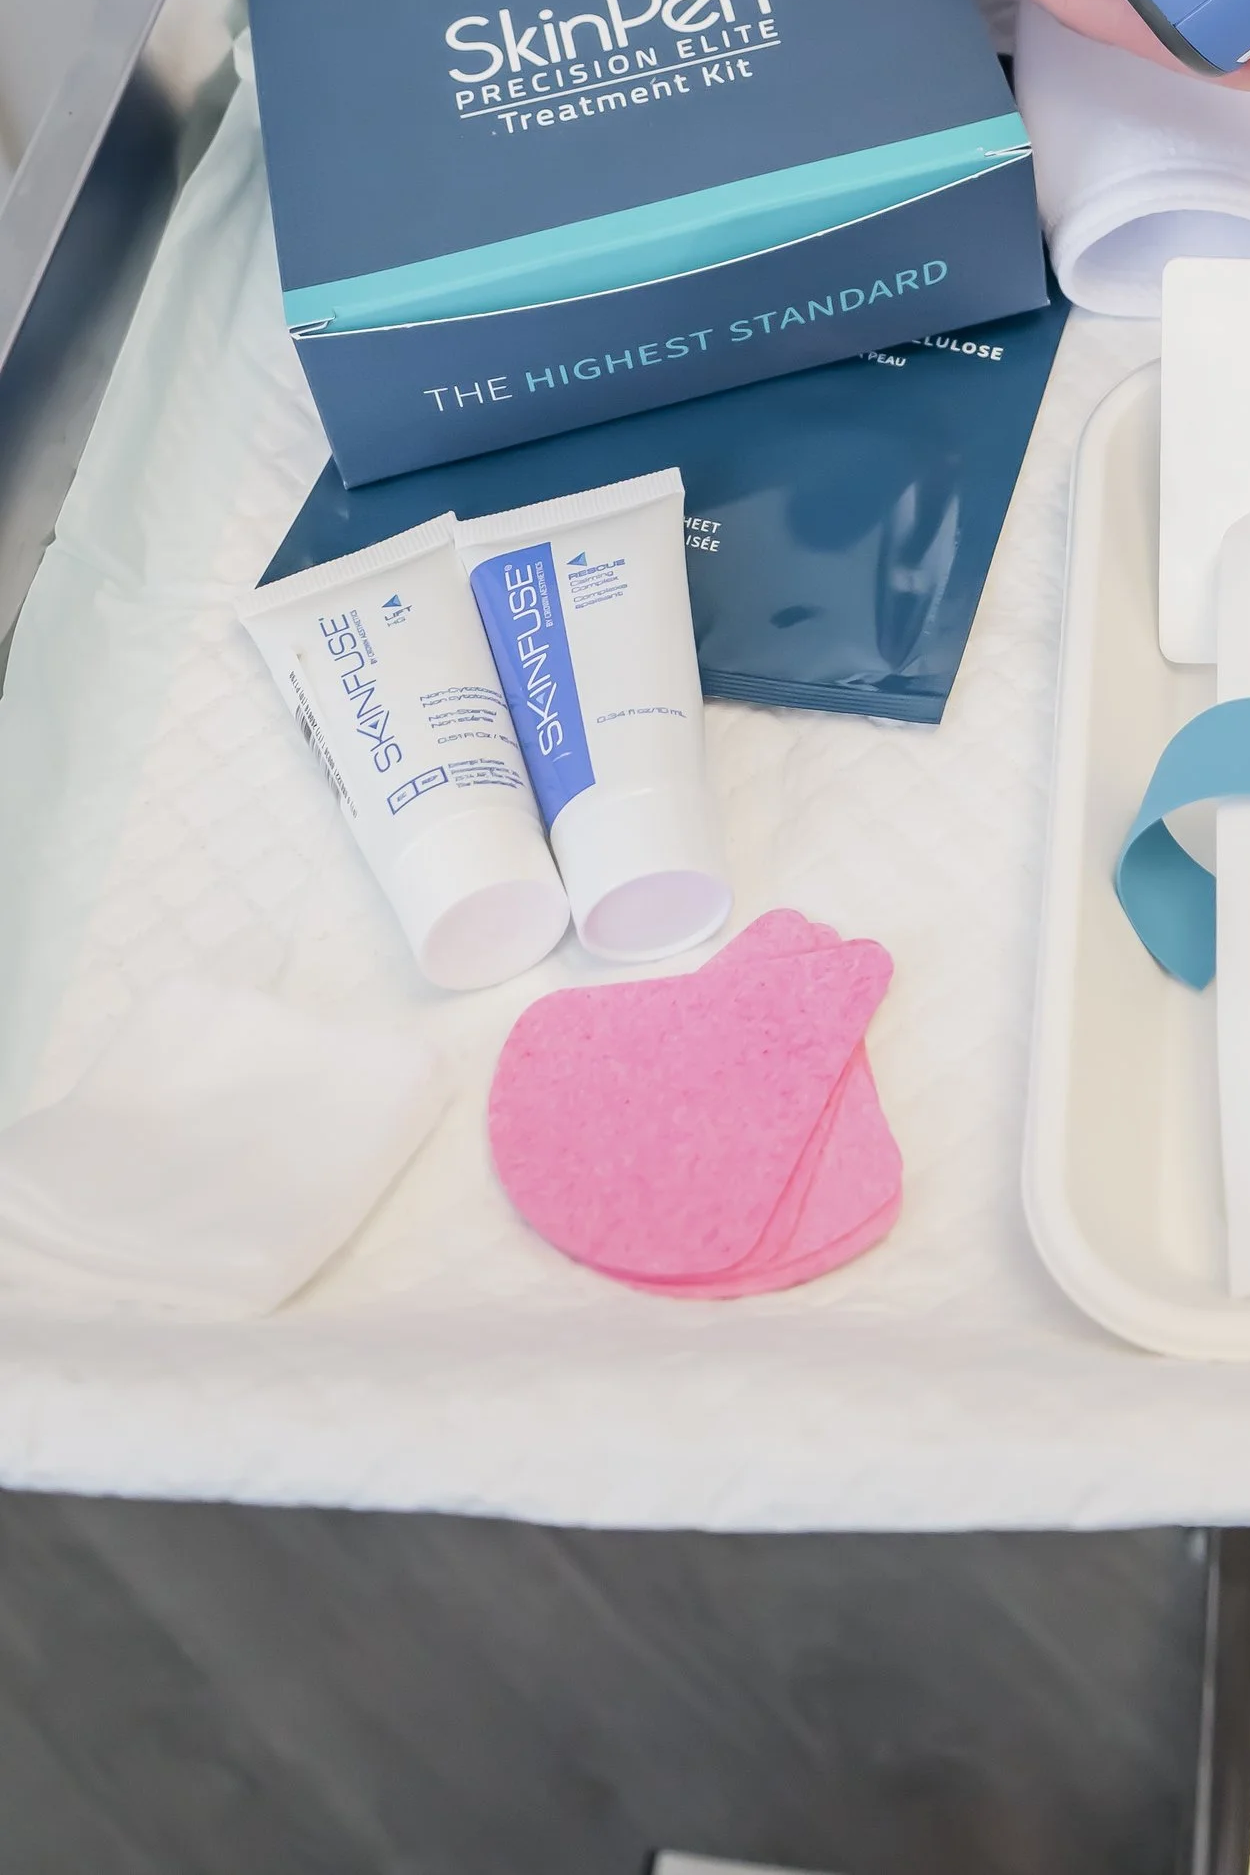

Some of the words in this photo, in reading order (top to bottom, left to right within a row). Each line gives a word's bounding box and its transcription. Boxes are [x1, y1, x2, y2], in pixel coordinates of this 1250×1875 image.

[455, 45, 658, 111] PRECISION
[676, 18, 781, 60] ELITE
[498, 72, 690, 135] Treatment
[703, 56, 754, 89] Kit
[423, 376, 513, 413] THE
[525, 328, 714, 394] HIGHEST
[729, 259, 949, 344] STANDARD
[867, 351, 907, 368] PEAU
[534, 561, 549, 601] AESTHETICS
[567, 558, 626, 581] RESCUE
